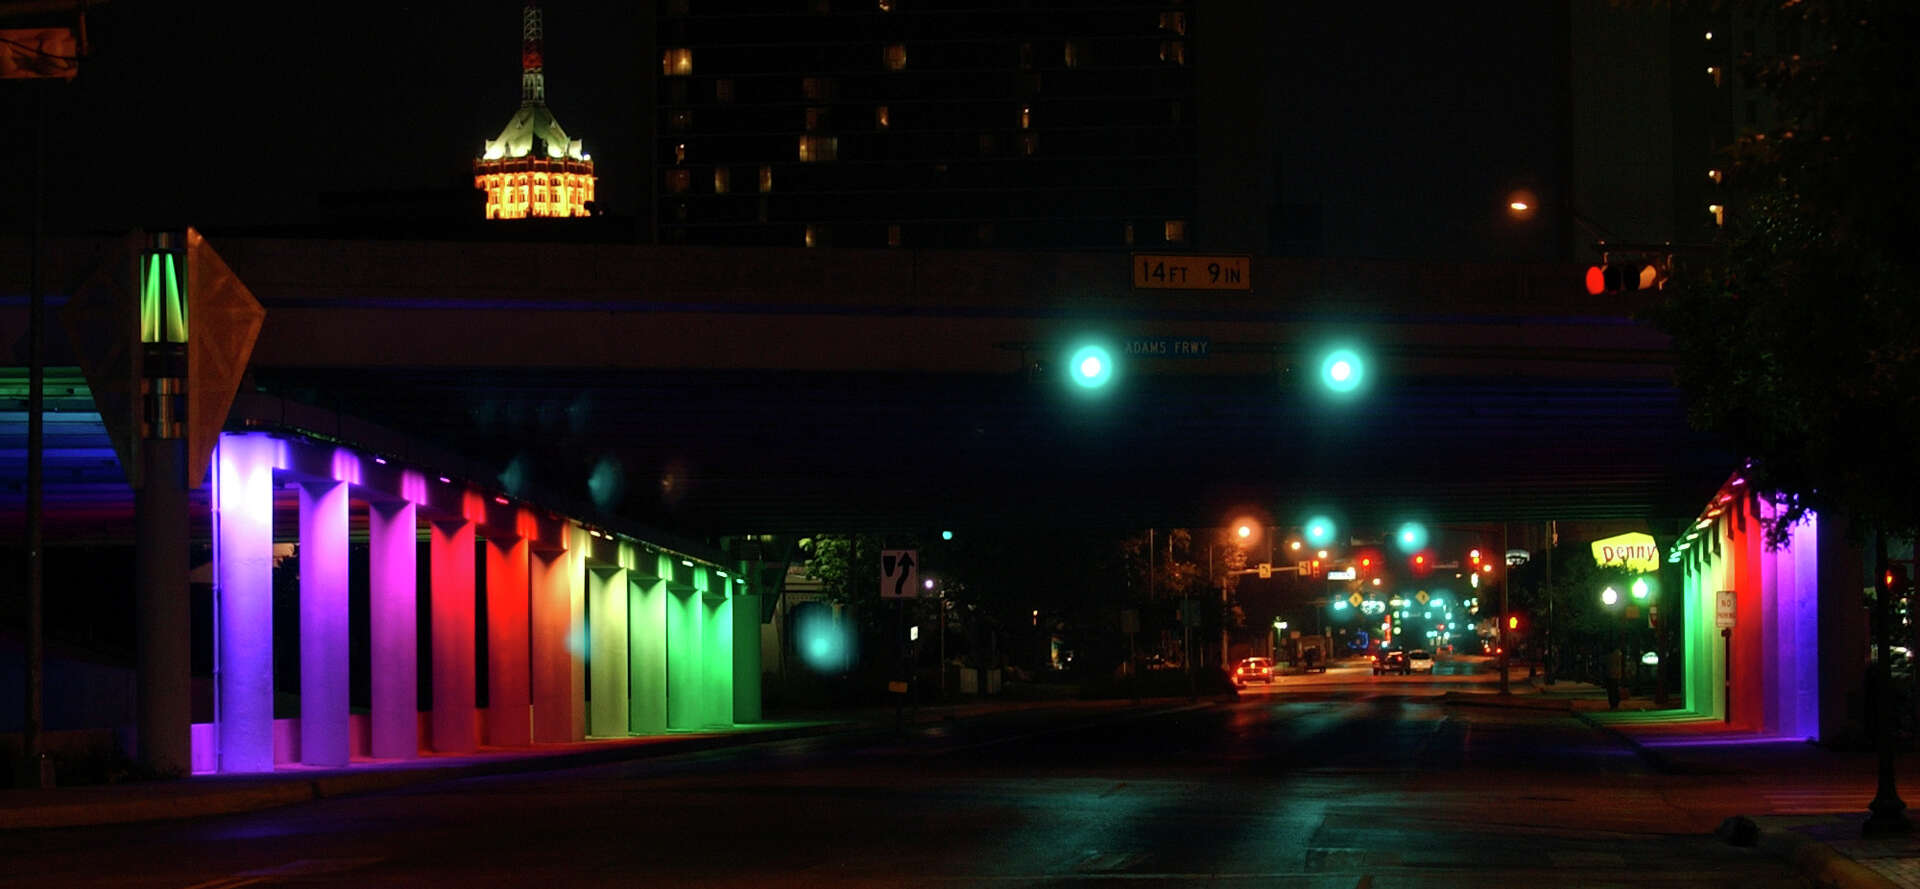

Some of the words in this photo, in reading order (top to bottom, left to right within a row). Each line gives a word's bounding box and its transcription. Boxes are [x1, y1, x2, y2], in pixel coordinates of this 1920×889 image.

[1126, 340, 1168, 355] ADAMS
[1174, 340, 1209, 355] FRWY
[1721, 599, 1732, 608] NO
